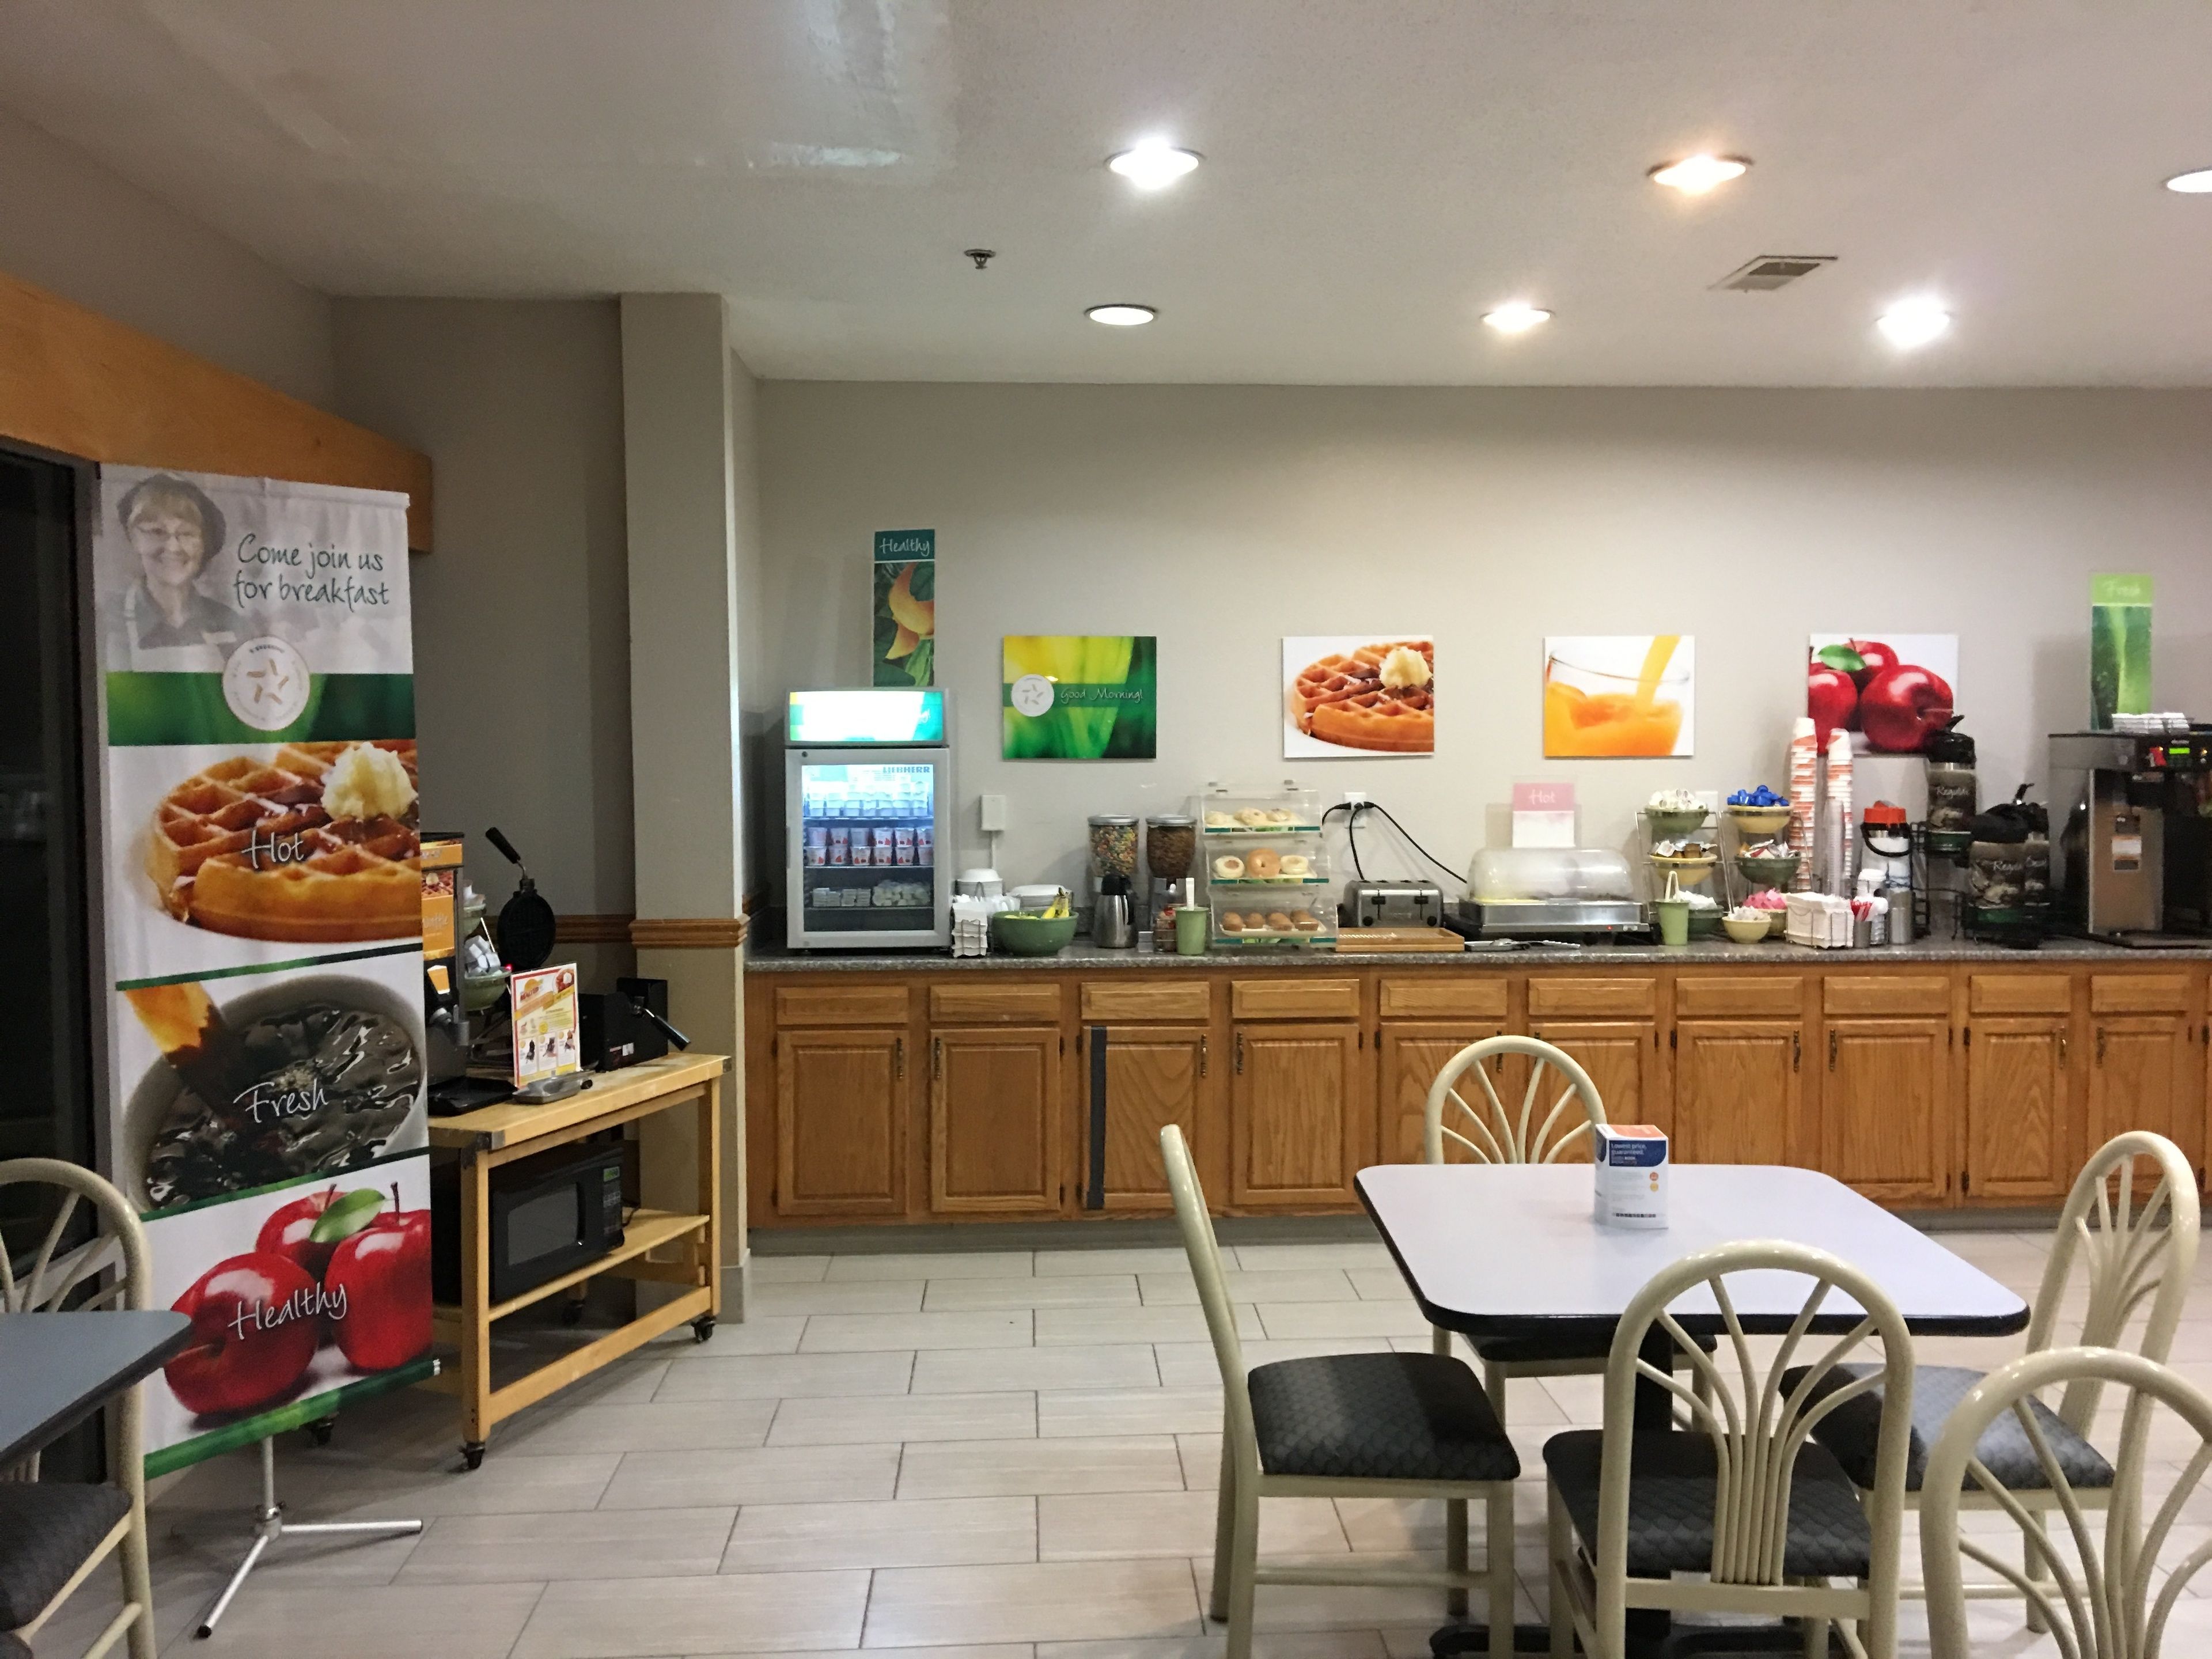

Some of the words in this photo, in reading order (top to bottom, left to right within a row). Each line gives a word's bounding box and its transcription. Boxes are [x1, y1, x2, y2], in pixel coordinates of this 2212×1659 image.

[238, 533, 302, 566] Come
[305, 543, 351, 579] join
[359, 554, 383, 571] us
[879, 538, 930, 557] Healthy
[234, 570, 272, 608] for
[279, 574, 389, 612] breakfast
[1060, 687, 1086, 704] Good
[1090, 687, 1143, 703] Morning!
[1528, 789, 1556, 805] Hot
[241, 826, 304, 869] Hot
[233, 1077, 328, 1123] Fresh
[228, 1281, 347, 1340] Healthy
